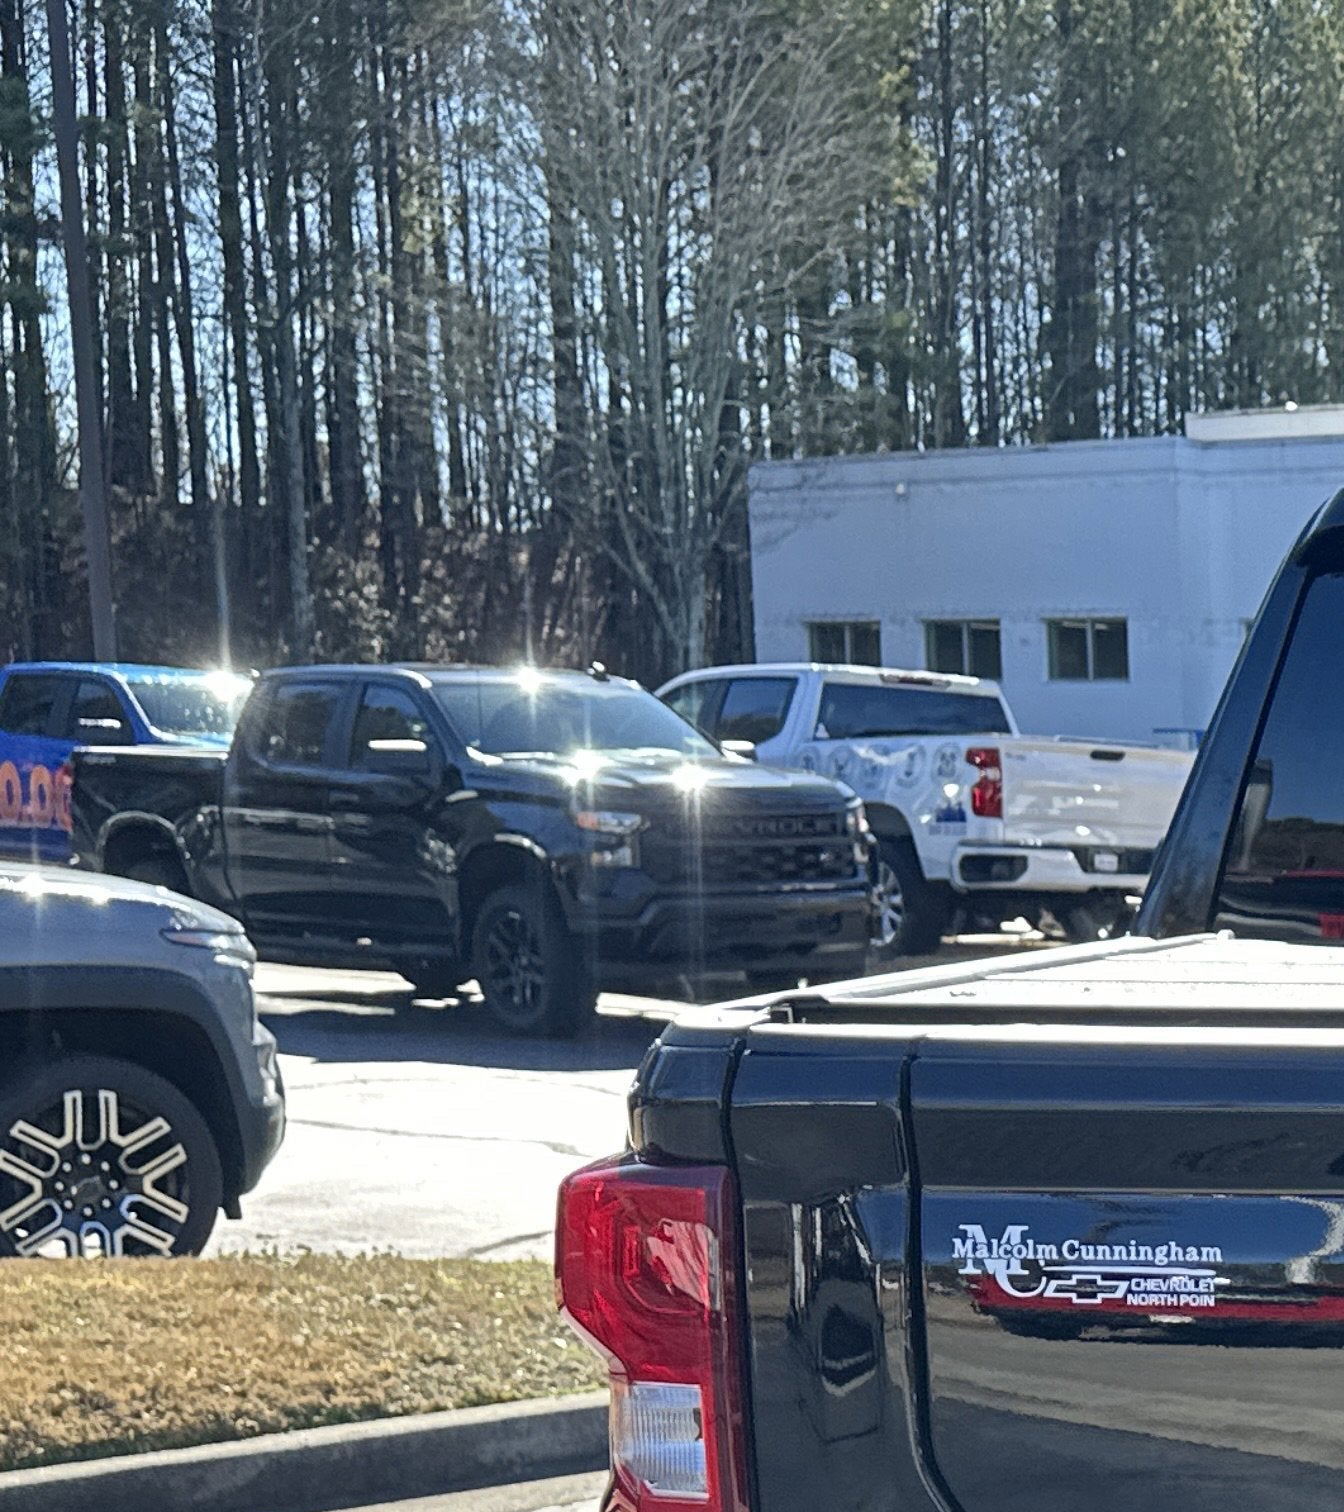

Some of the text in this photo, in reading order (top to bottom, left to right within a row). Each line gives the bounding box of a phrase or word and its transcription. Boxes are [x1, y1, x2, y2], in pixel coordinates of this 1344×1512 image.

[952, 1237, 1223, 1265] Malcolm Cunningham
[1130, 1276, 1216, 1292] CHEVROLET
[1126, 1293, 1179, 1307] NORTH
